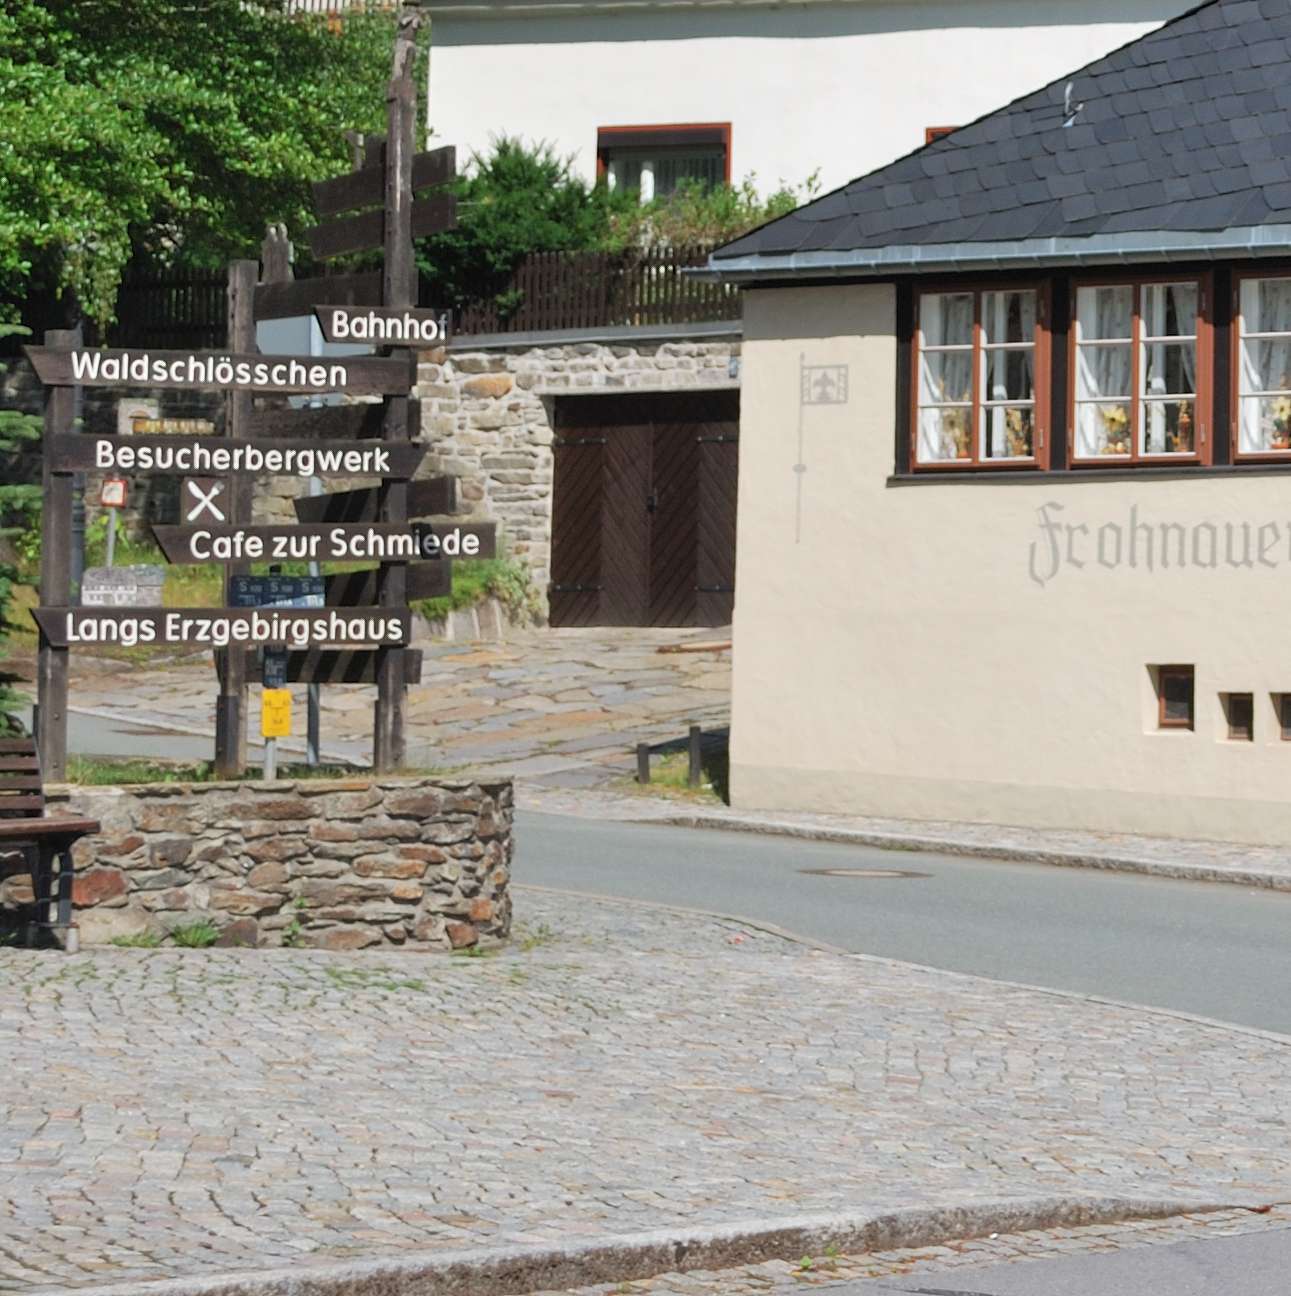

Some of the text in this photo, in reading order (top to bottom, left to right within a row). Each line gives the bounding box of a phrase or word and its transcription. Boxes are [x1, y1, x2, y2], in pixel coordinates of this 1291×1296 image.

[331, 310, 447, 341] Bahnhof
[71, 351, 347, 386] Waldschlösschen
[95, 440, 390, 476] Besucherbergwerk
[190, 528, 481, 559] Cafe zur Schmiede
[66, 611, 402, 646] Langs Erzgebirgshaus
